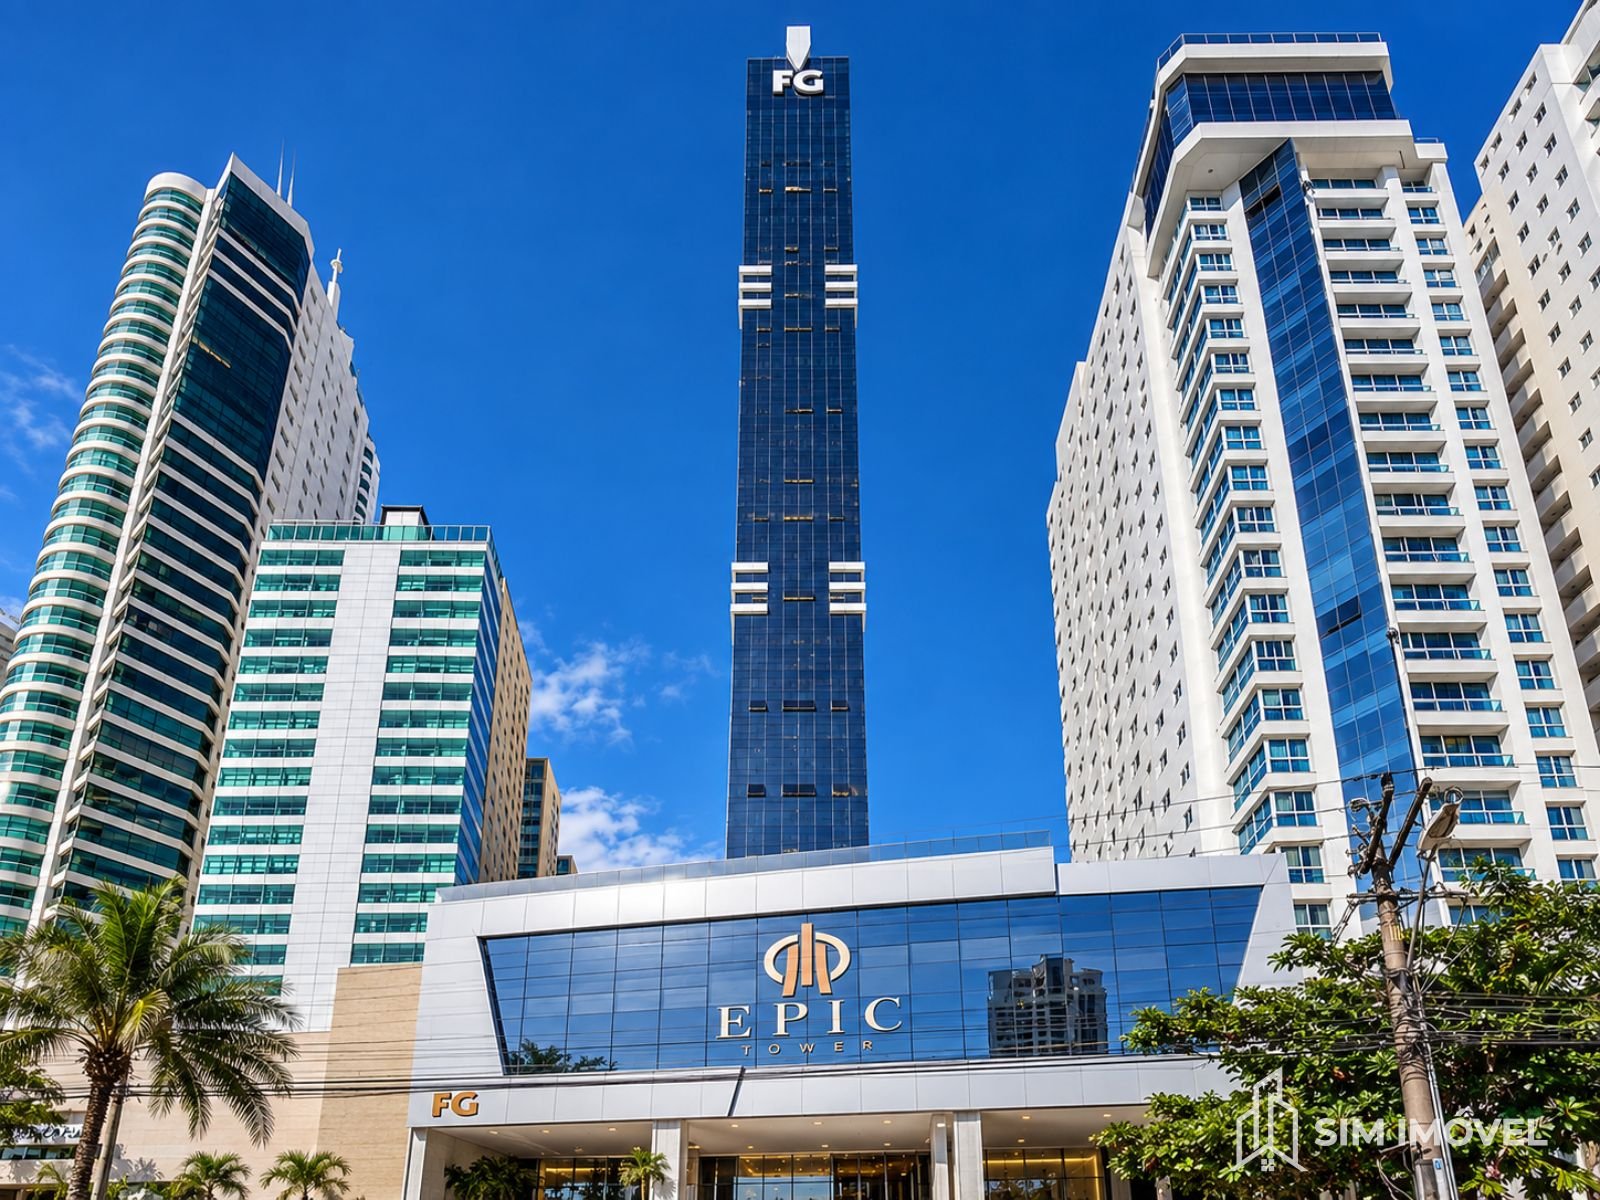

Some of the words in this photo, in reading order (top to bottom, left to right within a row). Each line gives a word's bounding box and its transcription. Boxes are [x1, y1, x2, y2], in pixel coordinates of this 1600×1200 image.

[772, 69, 824, 95] FG
[716, 997, 902, 1039] EPIC
[741, 1040, 873, 1056] TOWER
[432, 1091, 479, 1118] FG
